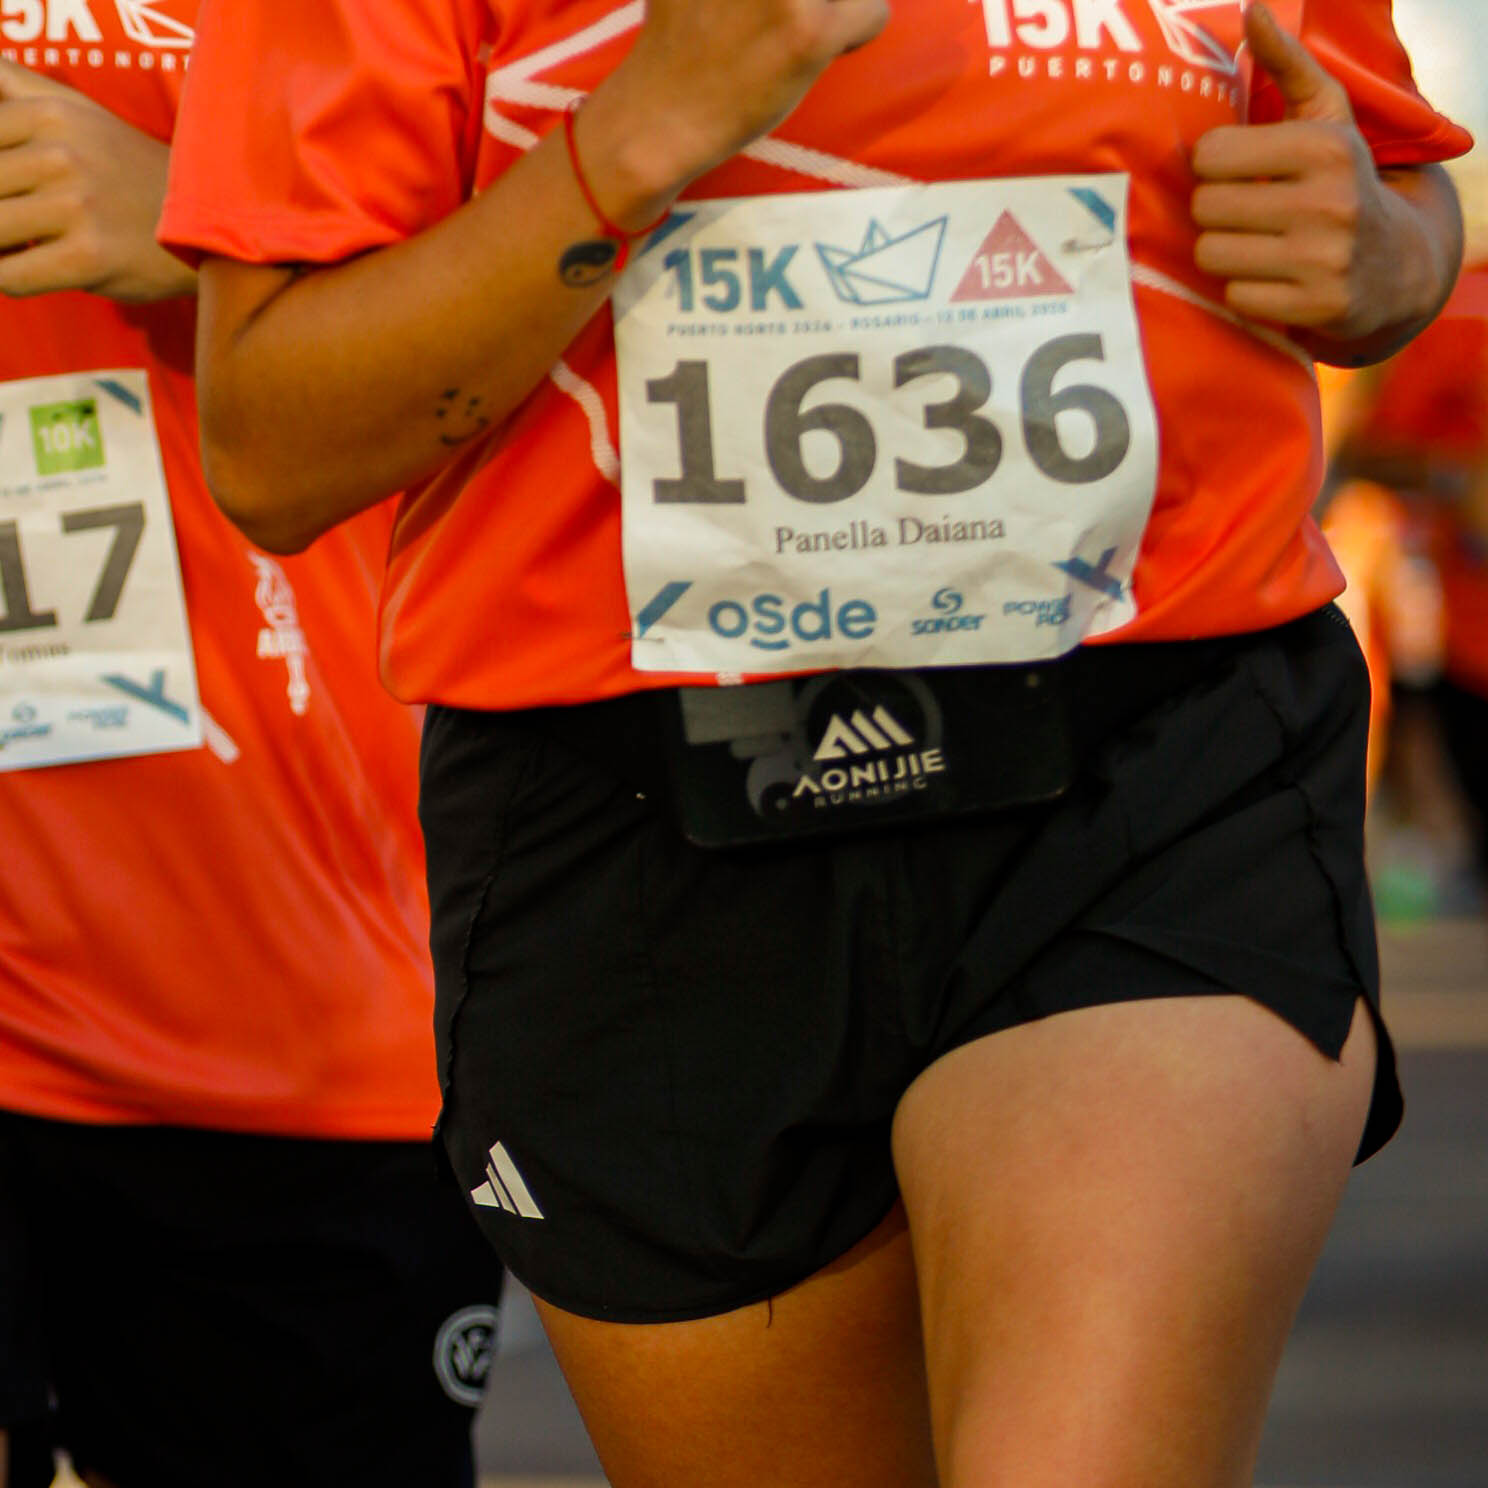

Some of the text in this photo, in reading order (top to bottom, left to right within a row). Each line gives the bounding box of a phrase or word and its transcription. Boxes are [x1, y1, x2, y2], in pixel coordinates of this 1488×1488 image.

[2, 47, 104, 68] UERTO
[989, 55, 1144, 82] PUERTO
[663, 245, 1044, 312] 15K 15K
[37, 422, 98, 454] 10K
[646, 333, 1130, 504] 1636
[774, 514, 1006, 554] Panella Daiana
[708, 589, 877, 648] osde
[792, 748, 947, 797] AONIJIE
